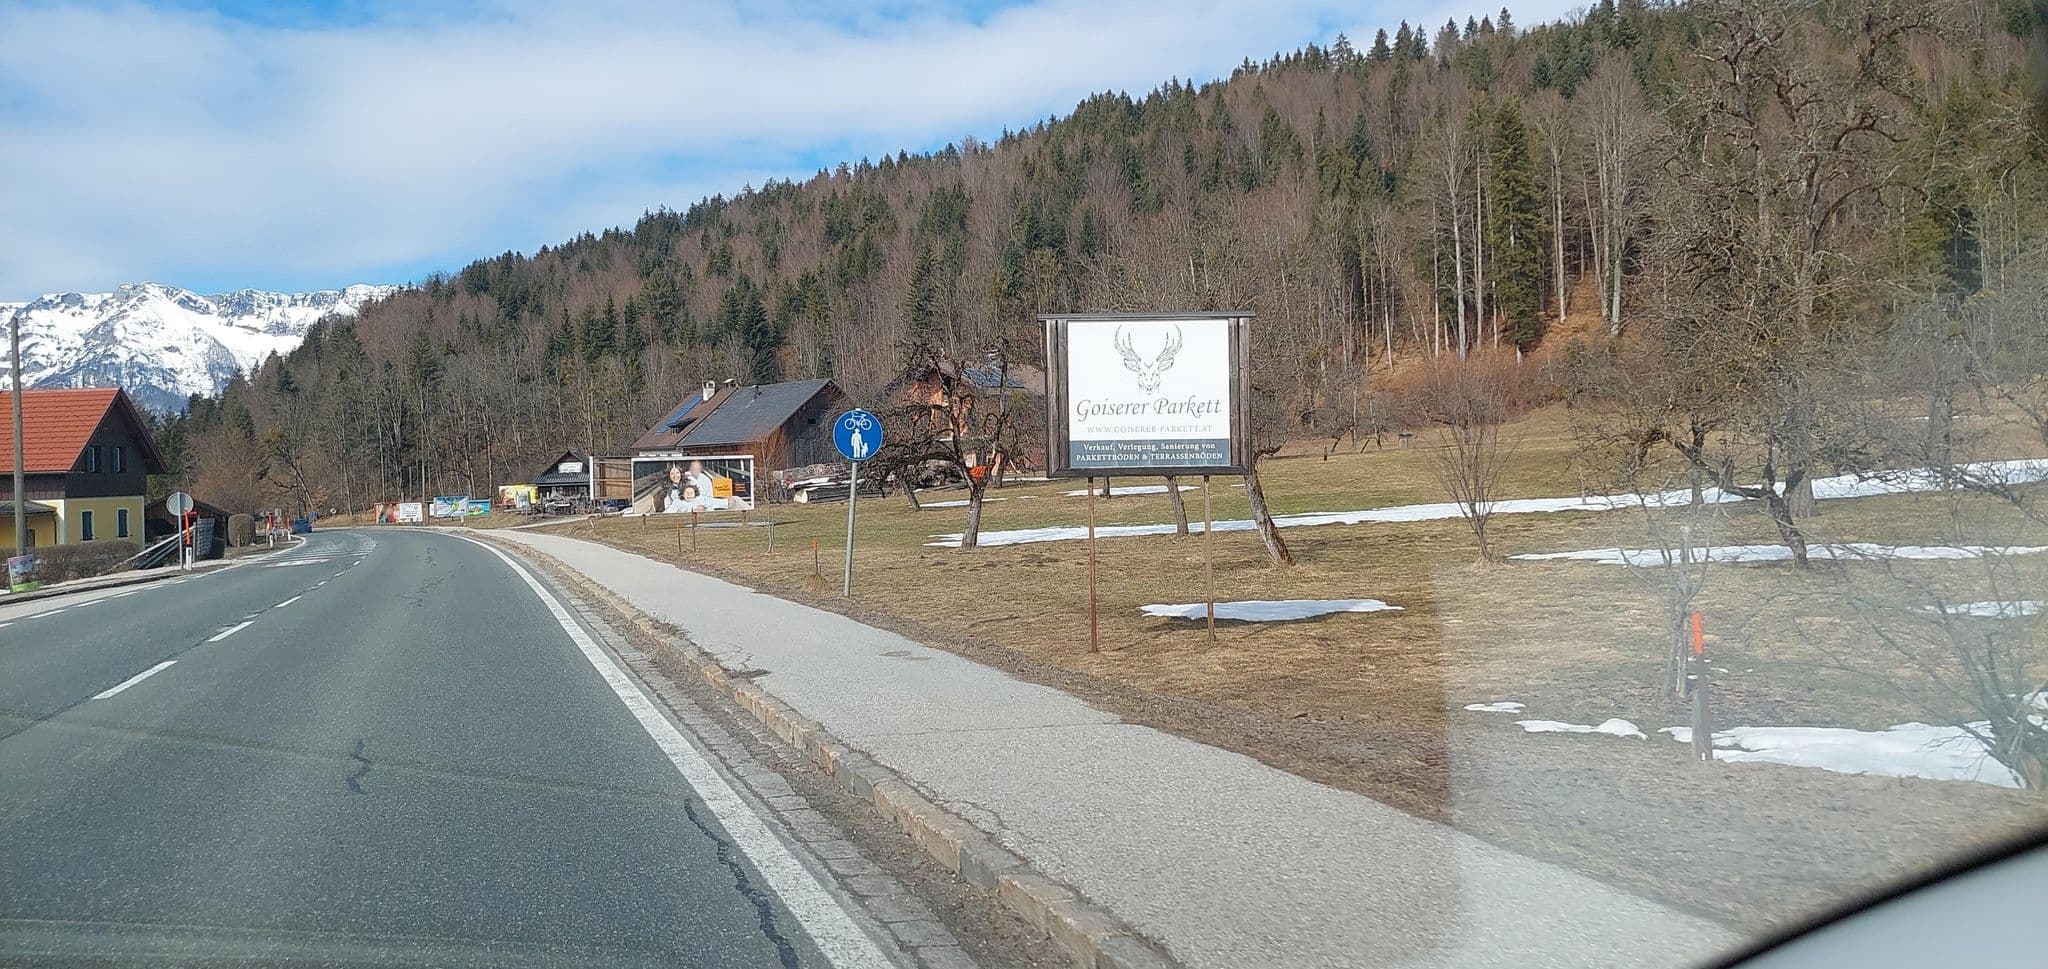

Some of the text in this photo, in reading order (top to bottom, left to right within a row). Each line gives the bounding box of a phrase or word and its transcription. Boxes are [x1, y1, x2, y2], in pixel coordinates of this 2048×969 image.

[1076, 395, 1222, 422] Goiserer Parkett
[1083, 443, 1116, 451] Verkauf,
[1118, 443, 1159, 452] Verlegung,
[1160, 442, 1199, 451] Sanierung
[1076, 453, 1140, 461] PARKETTBÖDEN
[1149, 452, 1223, 460] TERRASSENBÖDEN
